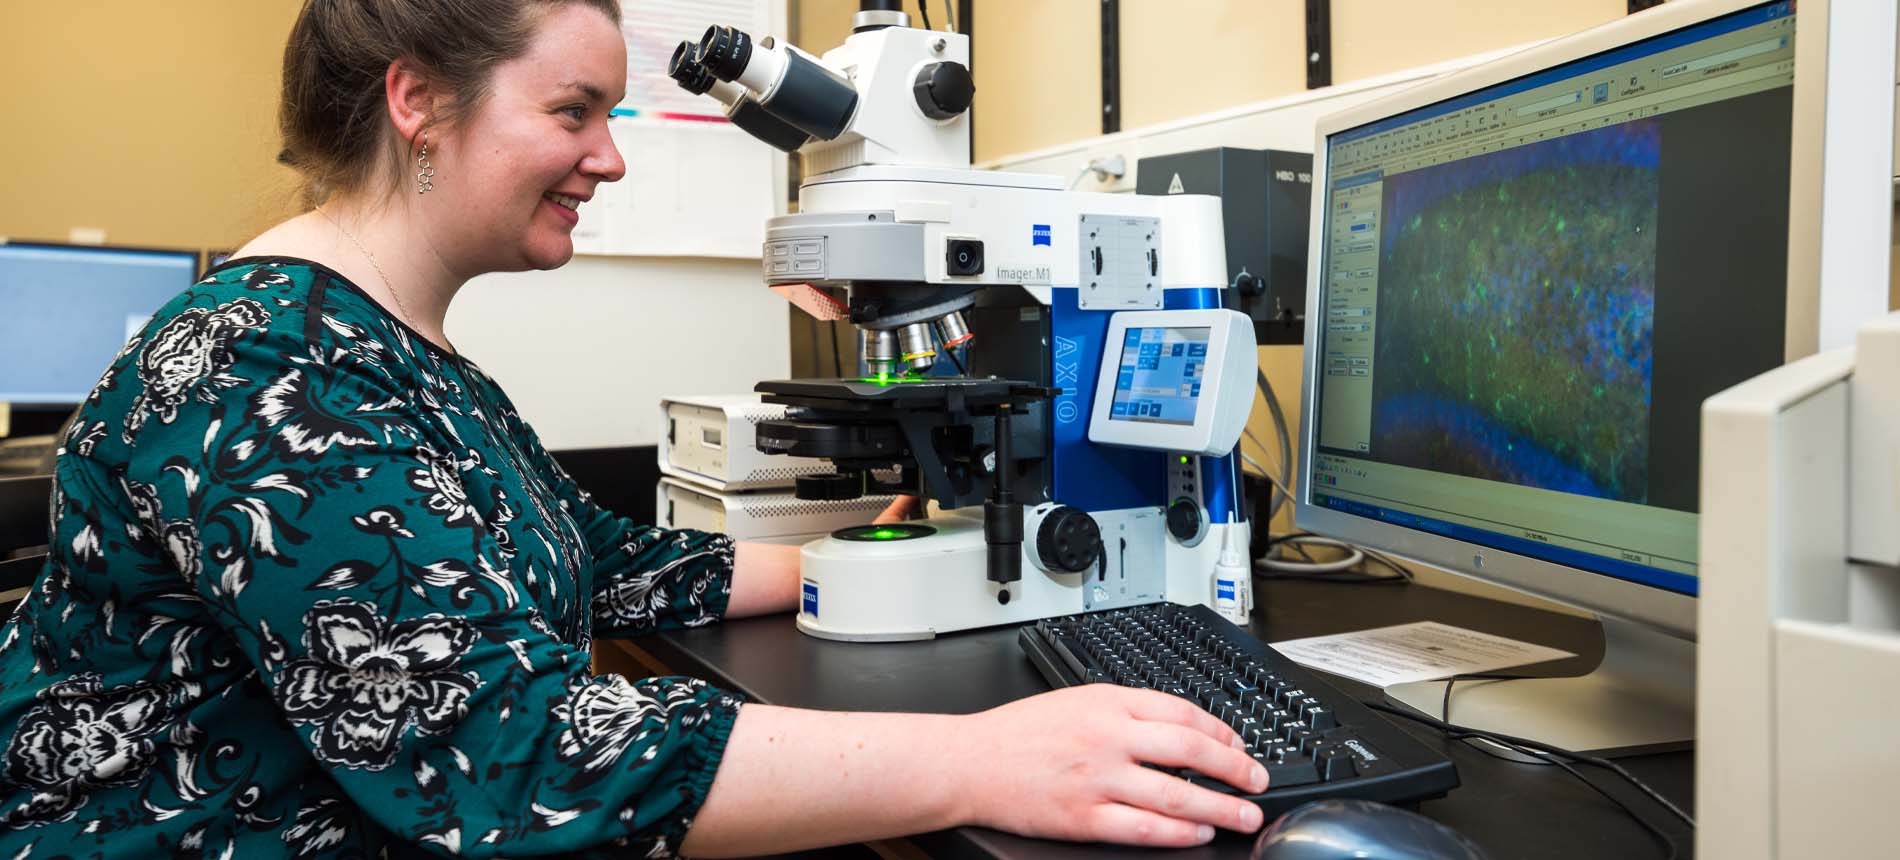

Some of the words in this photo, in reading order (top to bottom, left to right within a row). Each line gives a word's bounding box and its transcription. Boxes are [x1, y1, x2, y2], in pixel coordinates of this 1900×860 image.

[1275, 170, 1295, 181] HBO
[1055, 335, 1078, 424] AXIO
[1344, 739, 1379, 761] Gateway
